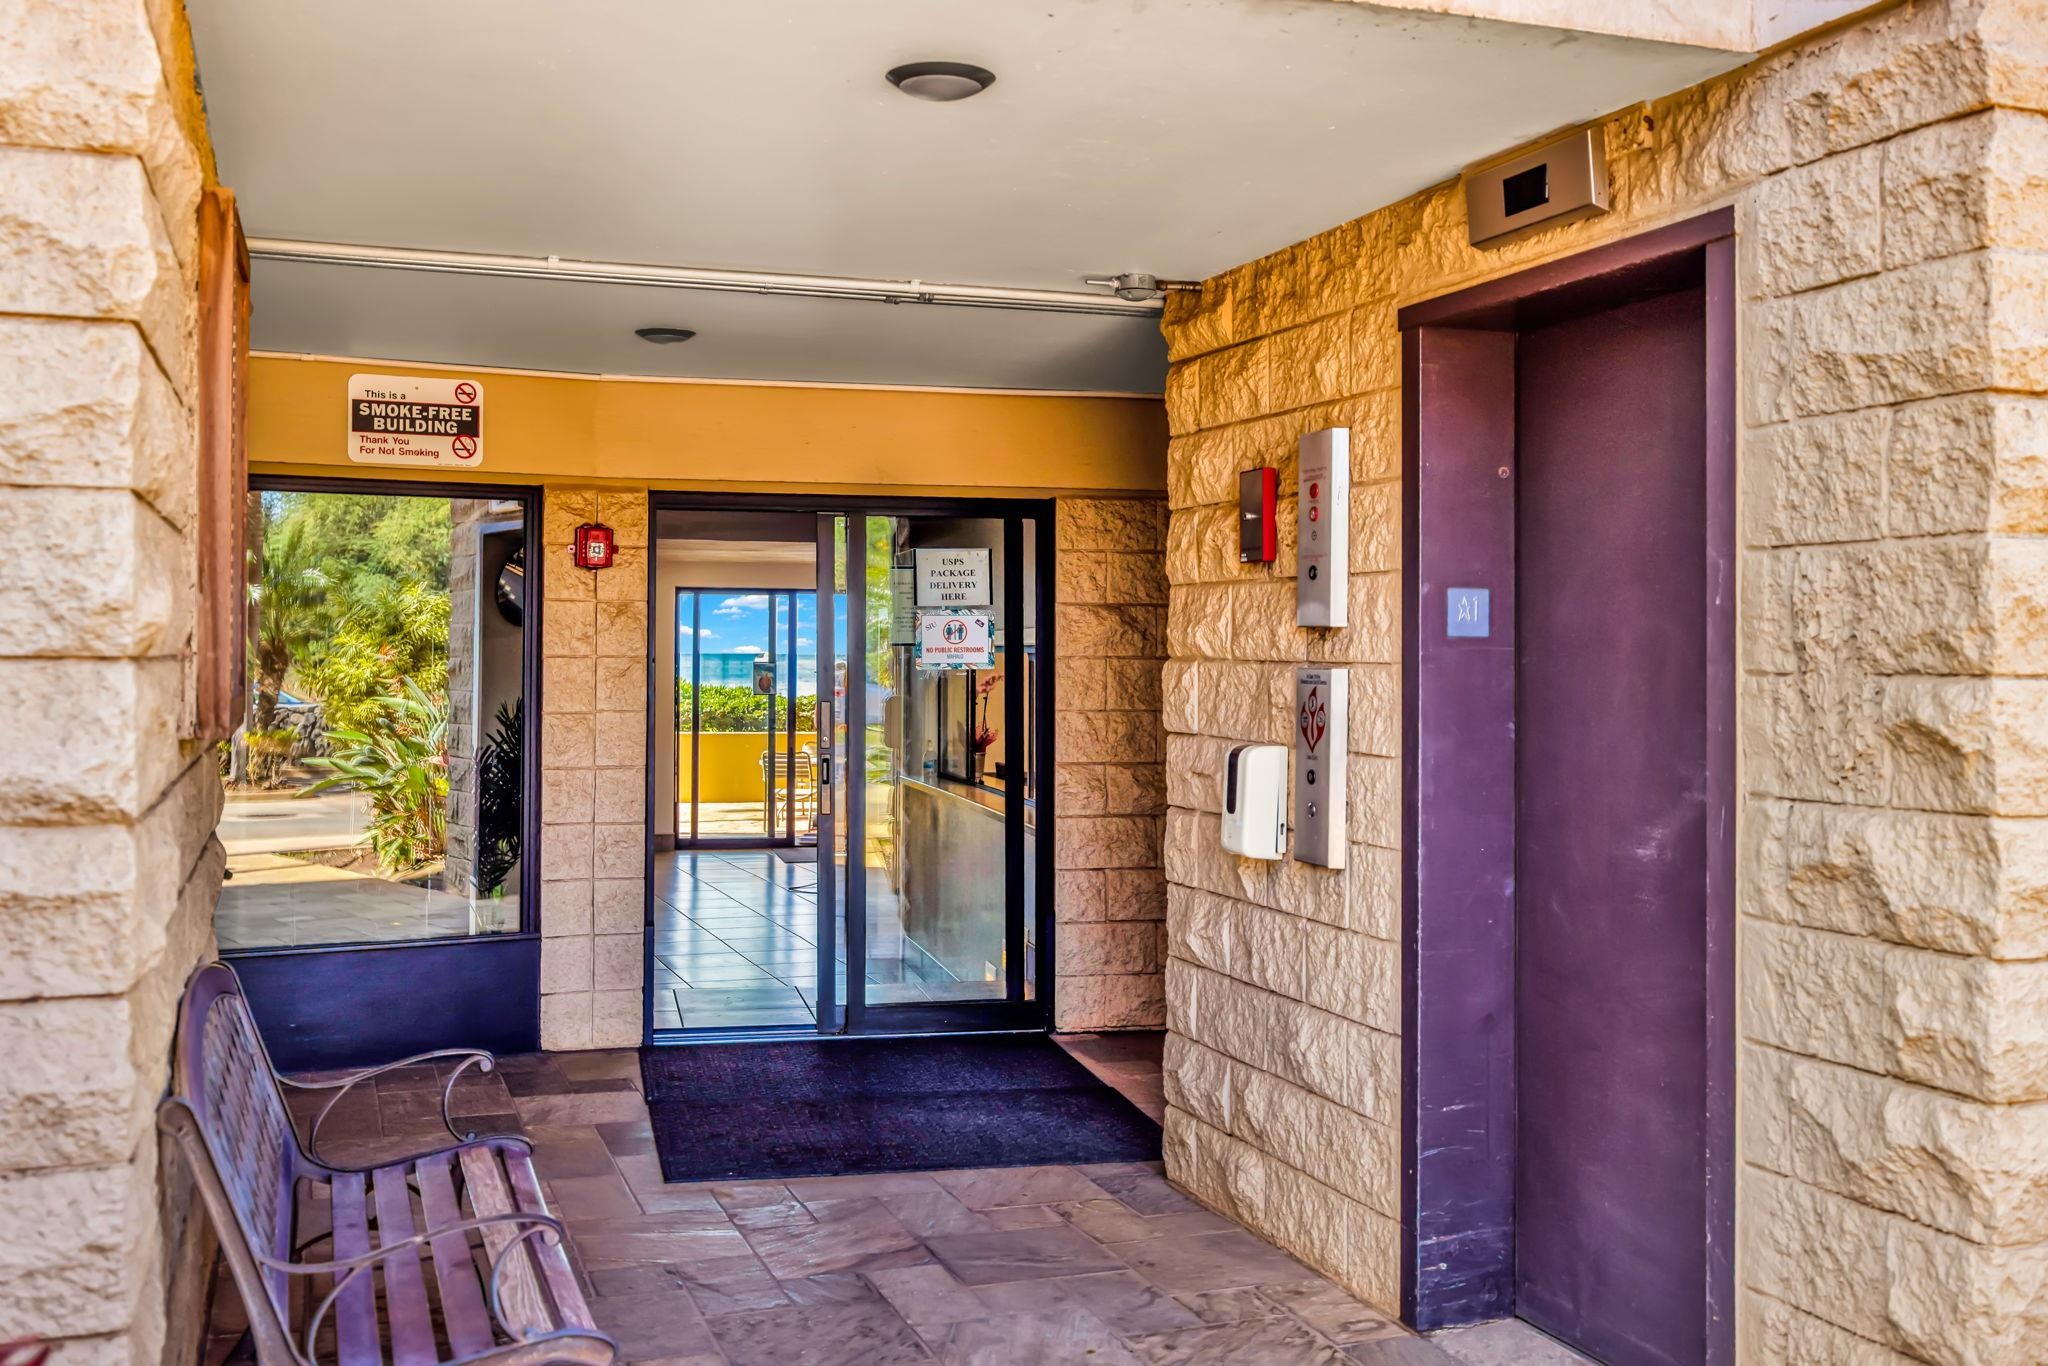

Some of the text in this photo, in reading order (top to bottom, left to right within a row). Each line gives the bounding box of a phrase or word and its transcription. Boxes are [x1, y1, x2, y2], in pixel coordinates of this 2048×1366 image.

[364, 389, 386, 399] This
[389, 391, 398, 400] is
[359, 402, 472, 421] SMOKE-FREE
[373, 417, 458, 434] BUILDING
[360, 435, 410, 446] Thank You
[360, 446, 440, 459] For Not Smoking
[942, 558, 964, 566] USPS
[930, 568, 976, 577] PACKAGE
[930, 581, 977, 589] DELIVERY
[941, 593, 967, 601] HERE
